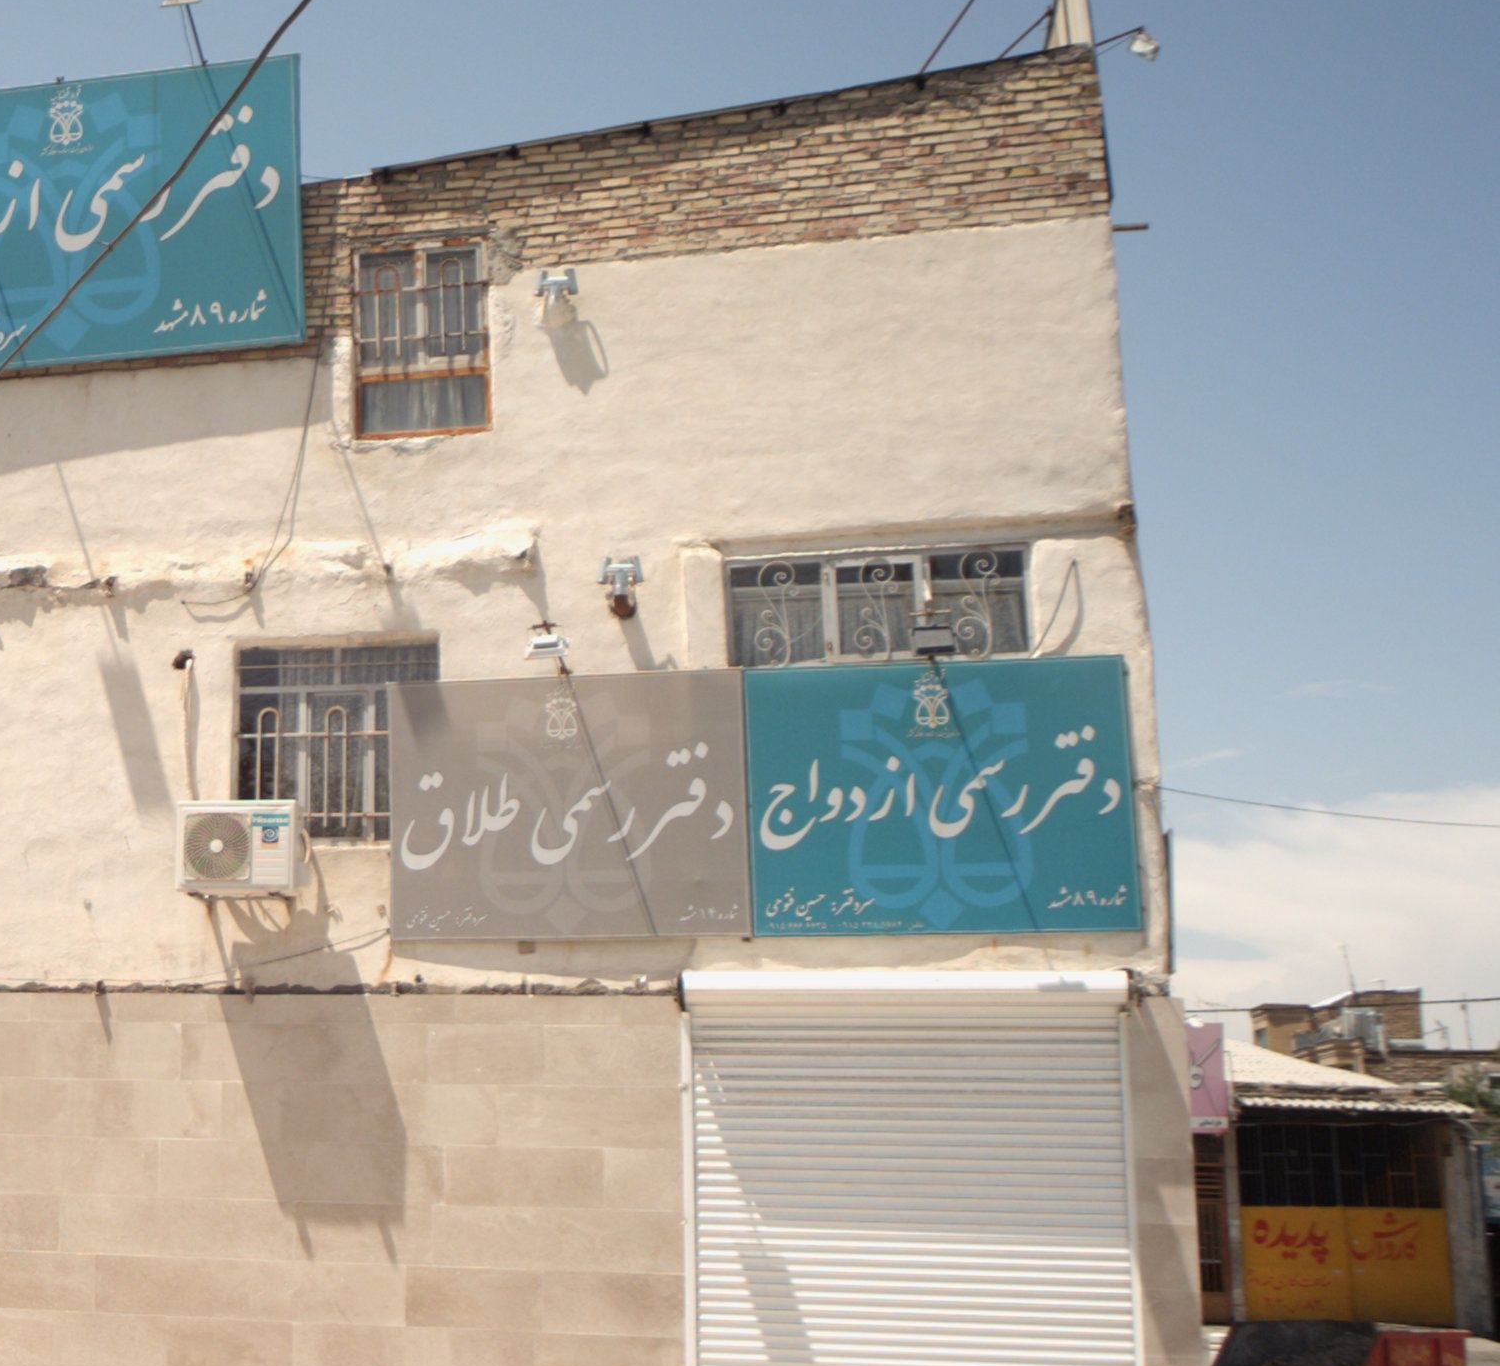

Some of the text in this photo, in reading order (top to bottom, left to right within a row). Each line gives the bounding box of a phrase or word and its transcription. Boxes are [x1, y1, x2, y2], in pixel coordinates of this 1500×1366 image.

[160, 105, 280, 241] دفتر
[55, 153, 171, 252] رسمی
[153, 288, 268, 334] شماره ۸۹ مشهد
[401, 742, 733, 870] دفتر رسمی طلاق
[760, 724, 1122, 851] دفتر رسمی ازدواج
[795, 893, 827, 922] حسین
[1073, 890, 1098, 907] ۸۹
[1100, 883, 1128, 906] شماره
[1253, 1219, 1329, 1264] پدیده
